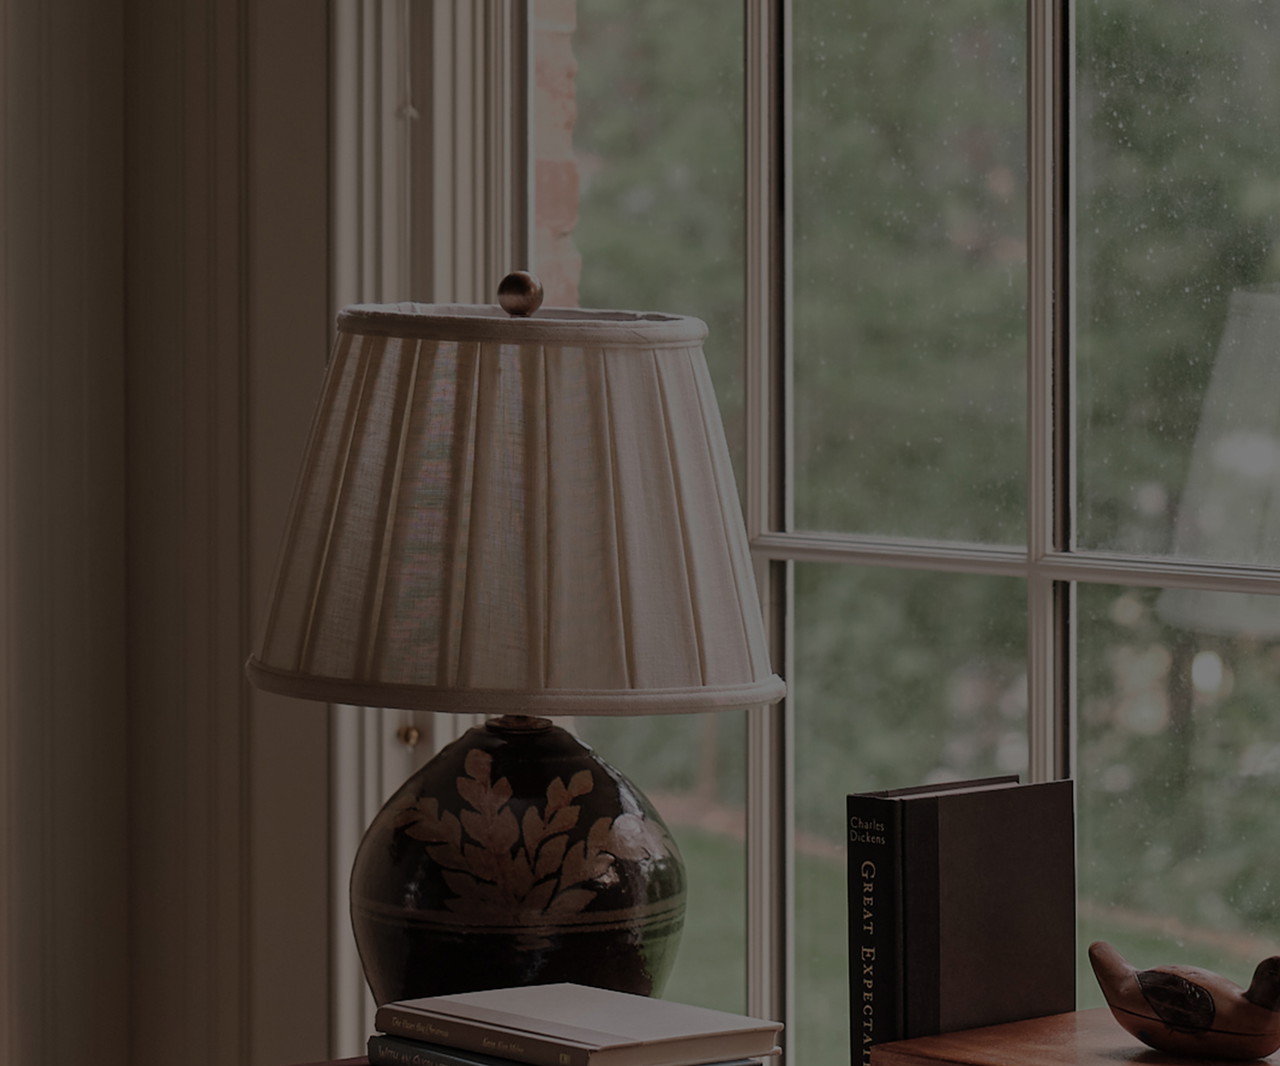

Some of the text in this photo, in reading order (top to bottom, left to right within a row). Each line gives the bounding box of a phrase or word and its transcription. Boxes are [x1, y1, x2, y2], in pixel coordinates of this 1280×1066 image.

[850, 816, 885, 831] Charles
[850, 829, 887, 846] Dickens
[861, 860, 877, 935] GREAT
